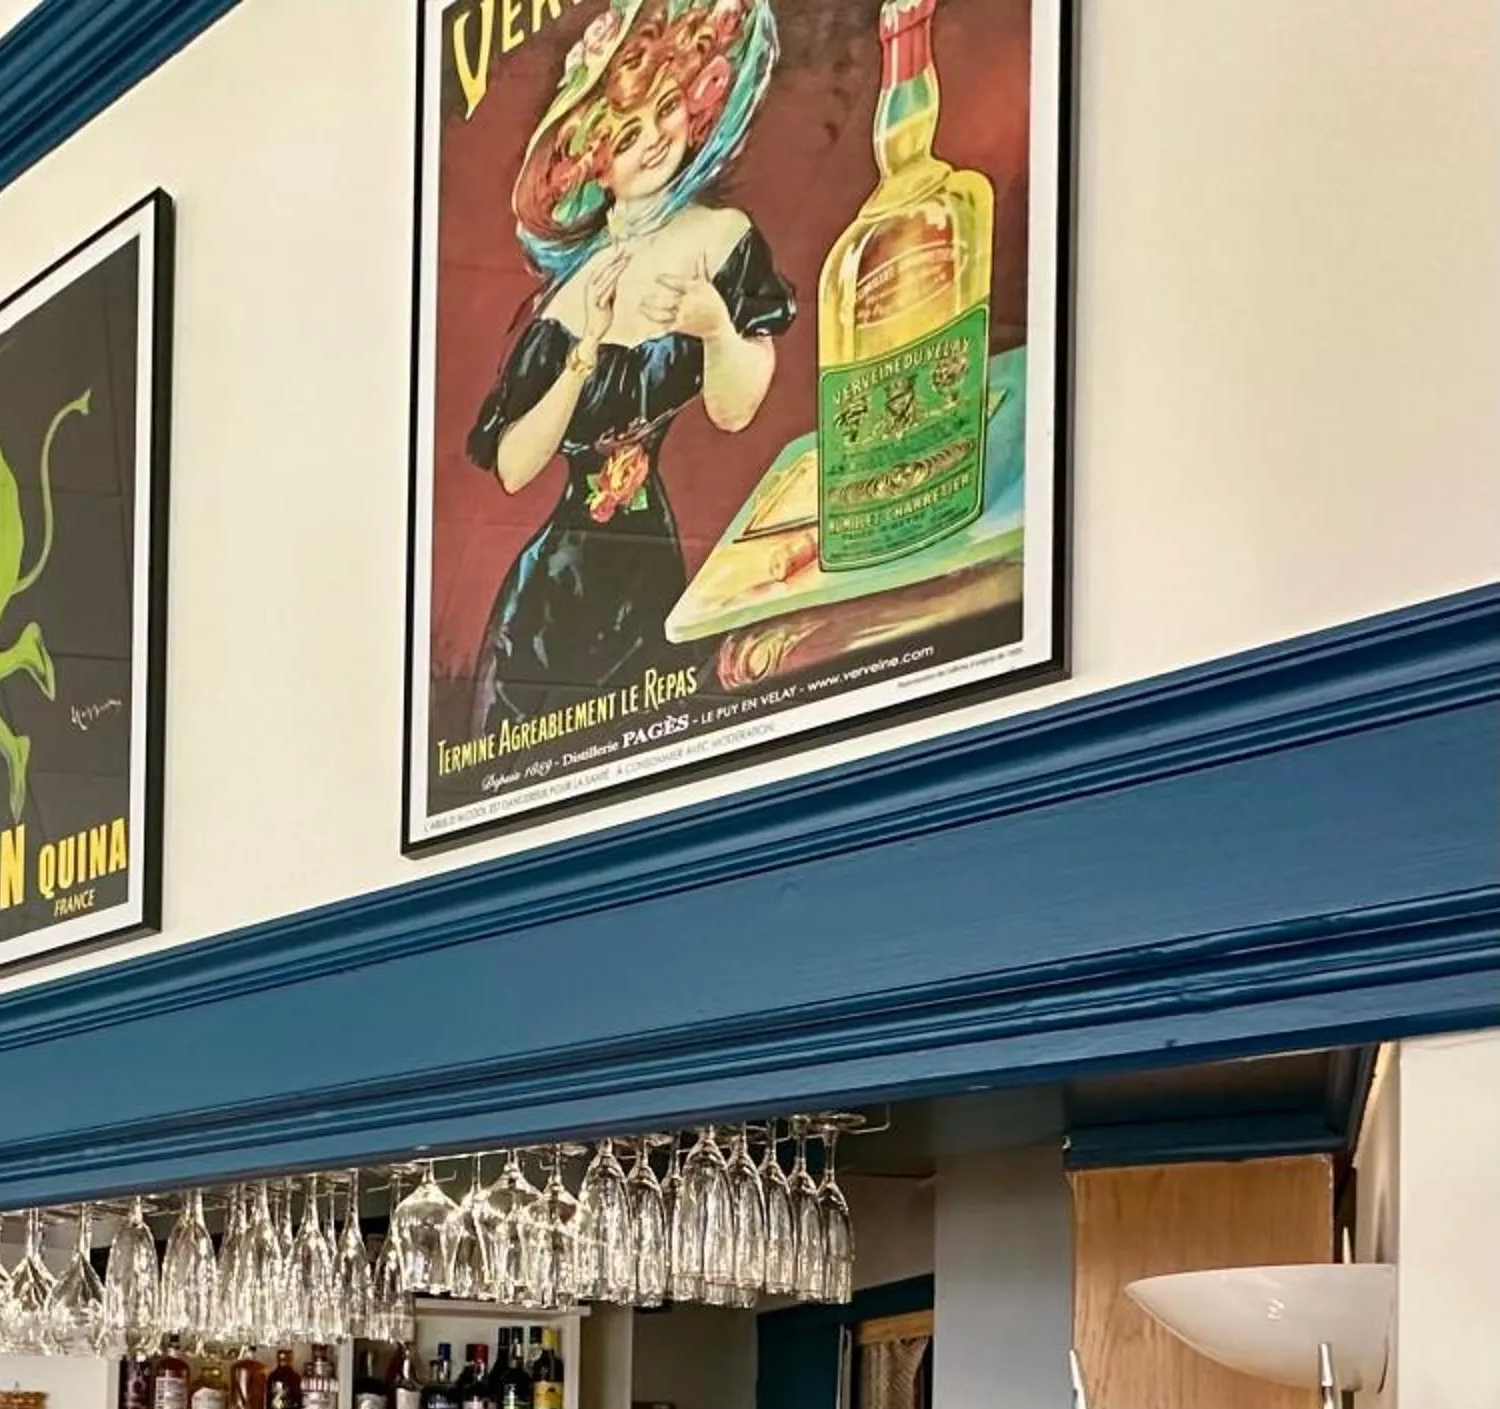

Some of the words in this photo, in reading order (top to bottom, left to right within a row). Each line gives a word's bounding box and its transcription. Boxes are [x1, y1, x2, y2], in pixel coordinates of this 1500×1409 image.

[437, 734, 496, 776] TERMINE
[498, 692, 617, 756] AGREABLEMENT
[621, 684, 639, 716] LE
[644, 666, 698, 711] REPAS
[562, 740, 620, 767] Distillerie
[622, 713, 690, 749] PAGÈS
[701, 713, 714, 725] LE
[716, 704, 739, 721] PUY
[741, 698, 758, 712] EN
[760, 684, 798, 706] VELAY
[807, 645, 935, 692] www.verveine.com
[38, 816, 128, 900] QUINA
[53, 888, 96, 918] FRANCE
